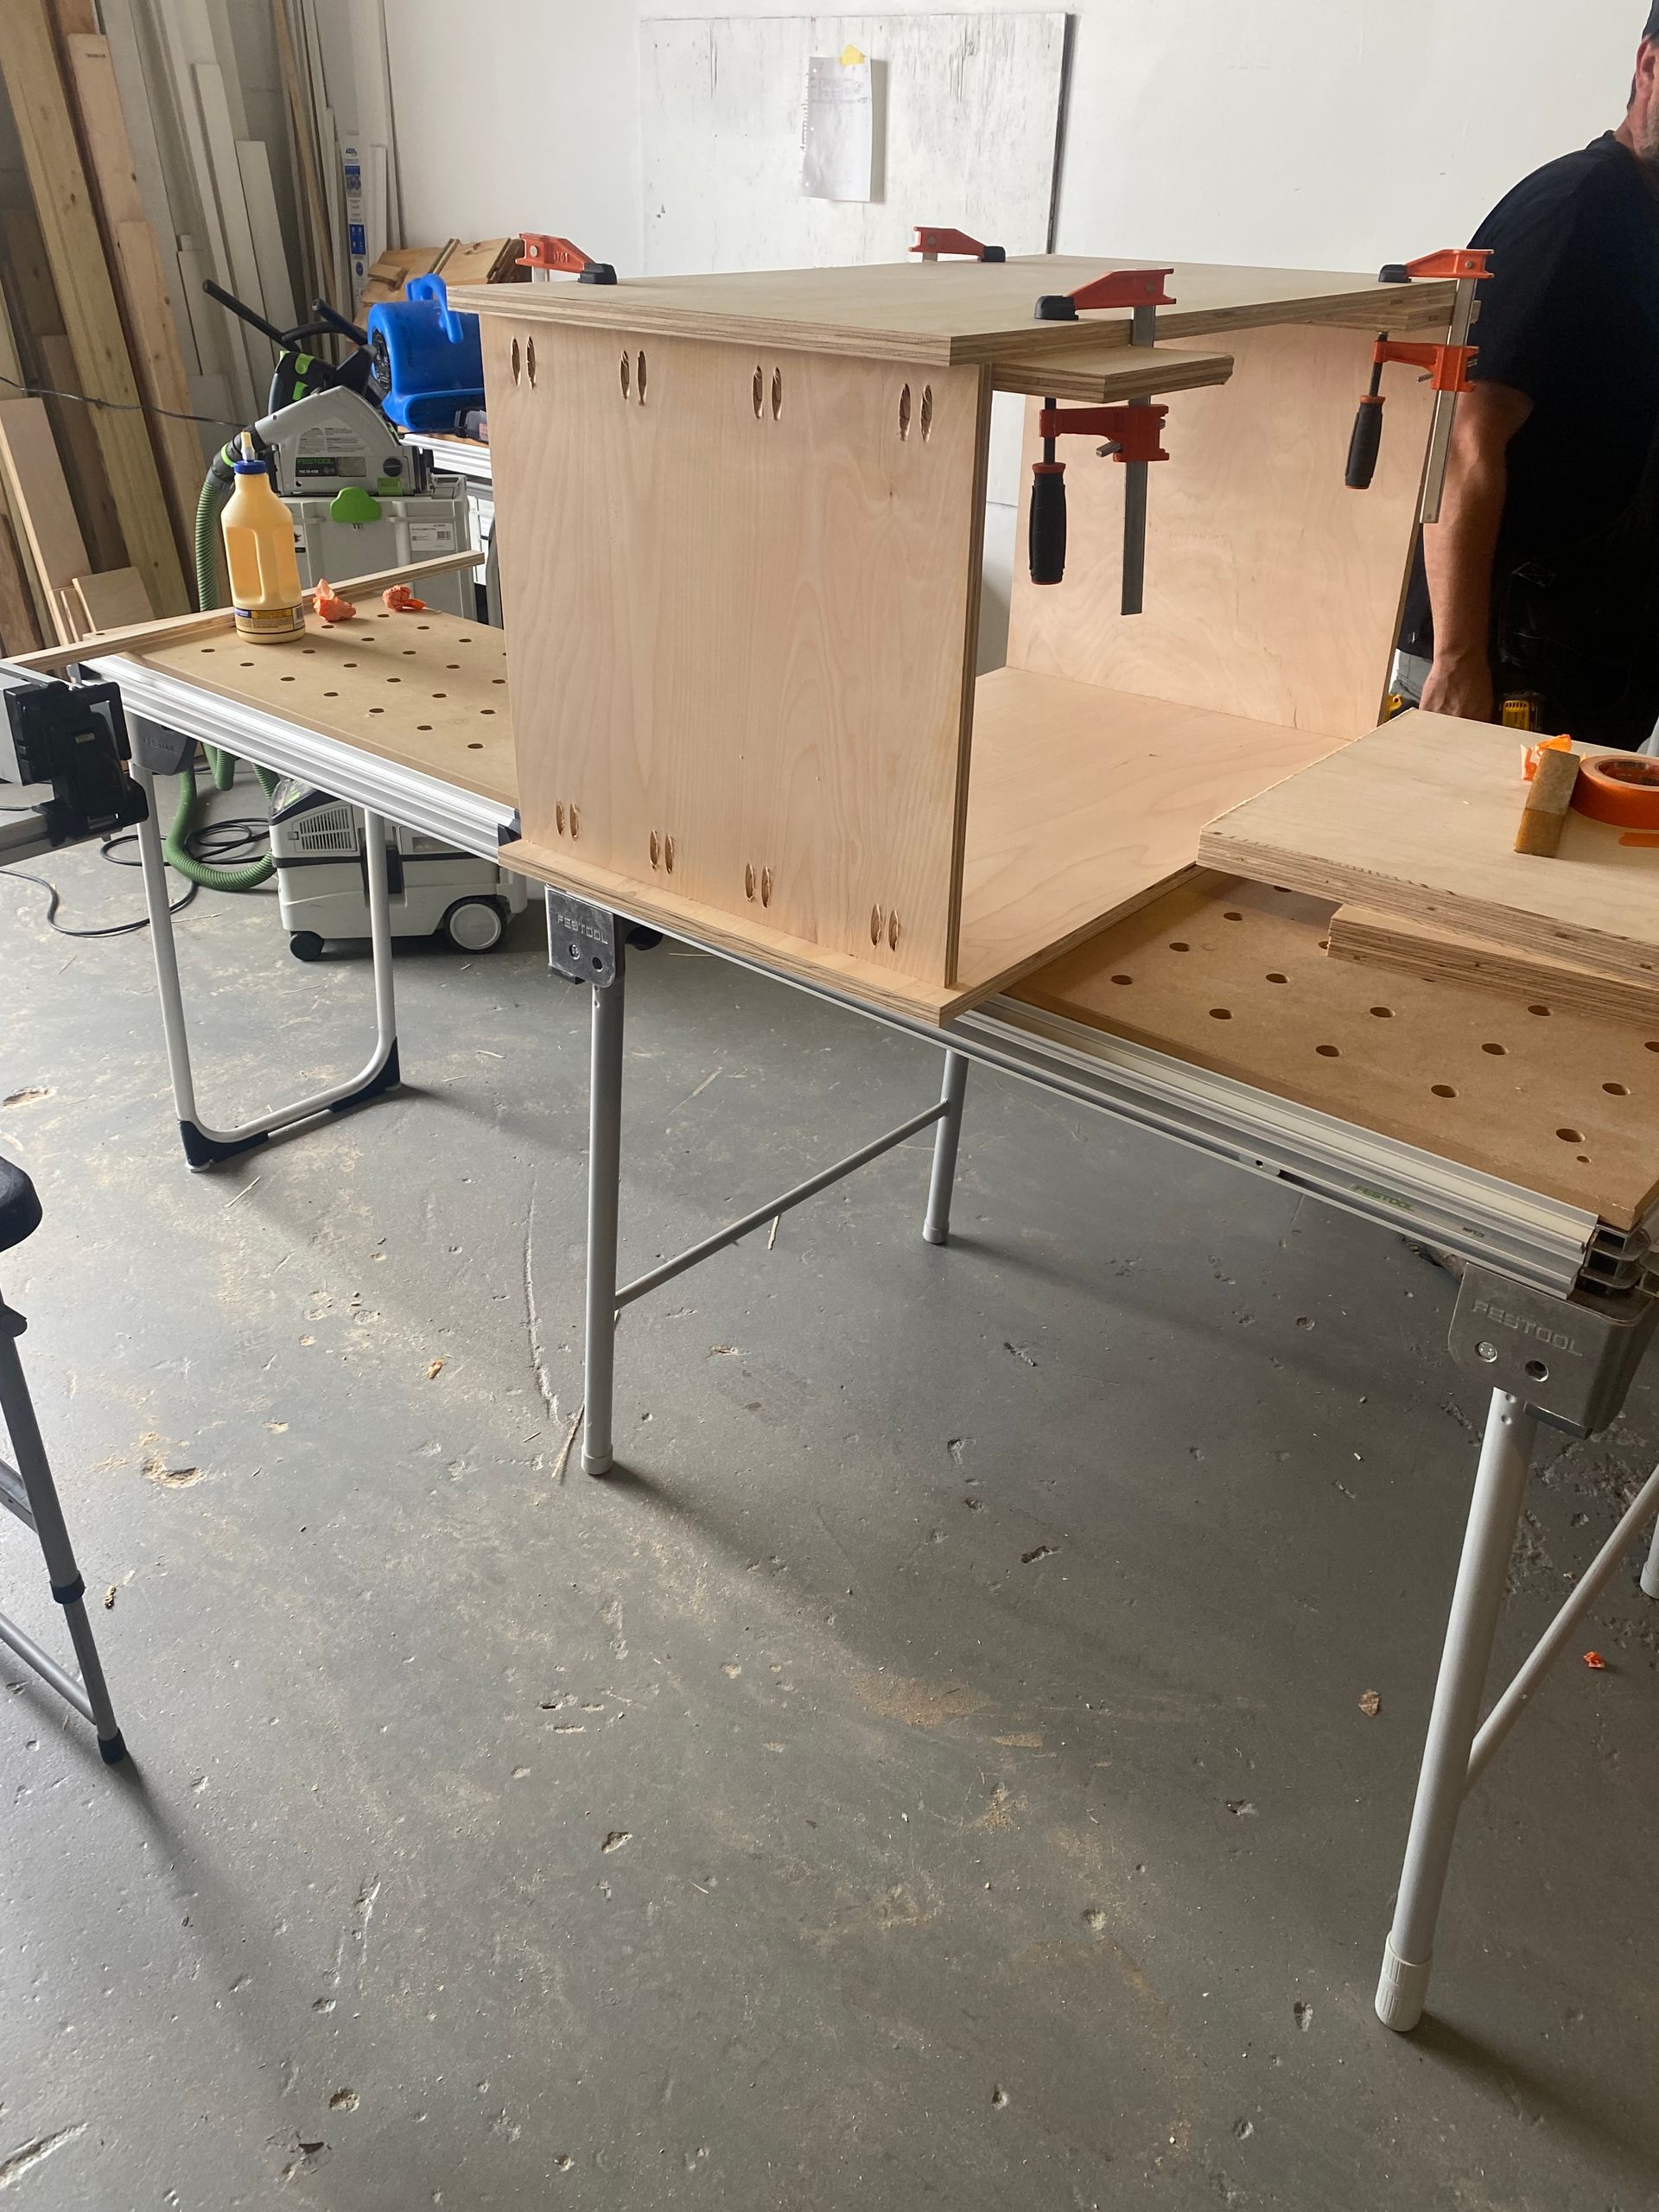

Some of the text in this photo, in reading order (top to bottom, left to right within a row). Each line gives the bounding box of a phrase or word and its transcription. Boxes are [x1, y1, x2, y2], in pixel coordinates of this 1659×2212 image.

[556, 913, 608, 944] FESTOOL
[1351, 1184, 1414, 1211] FESTOOL
[1472, 1299, 1583, 1357] FESTOOL
